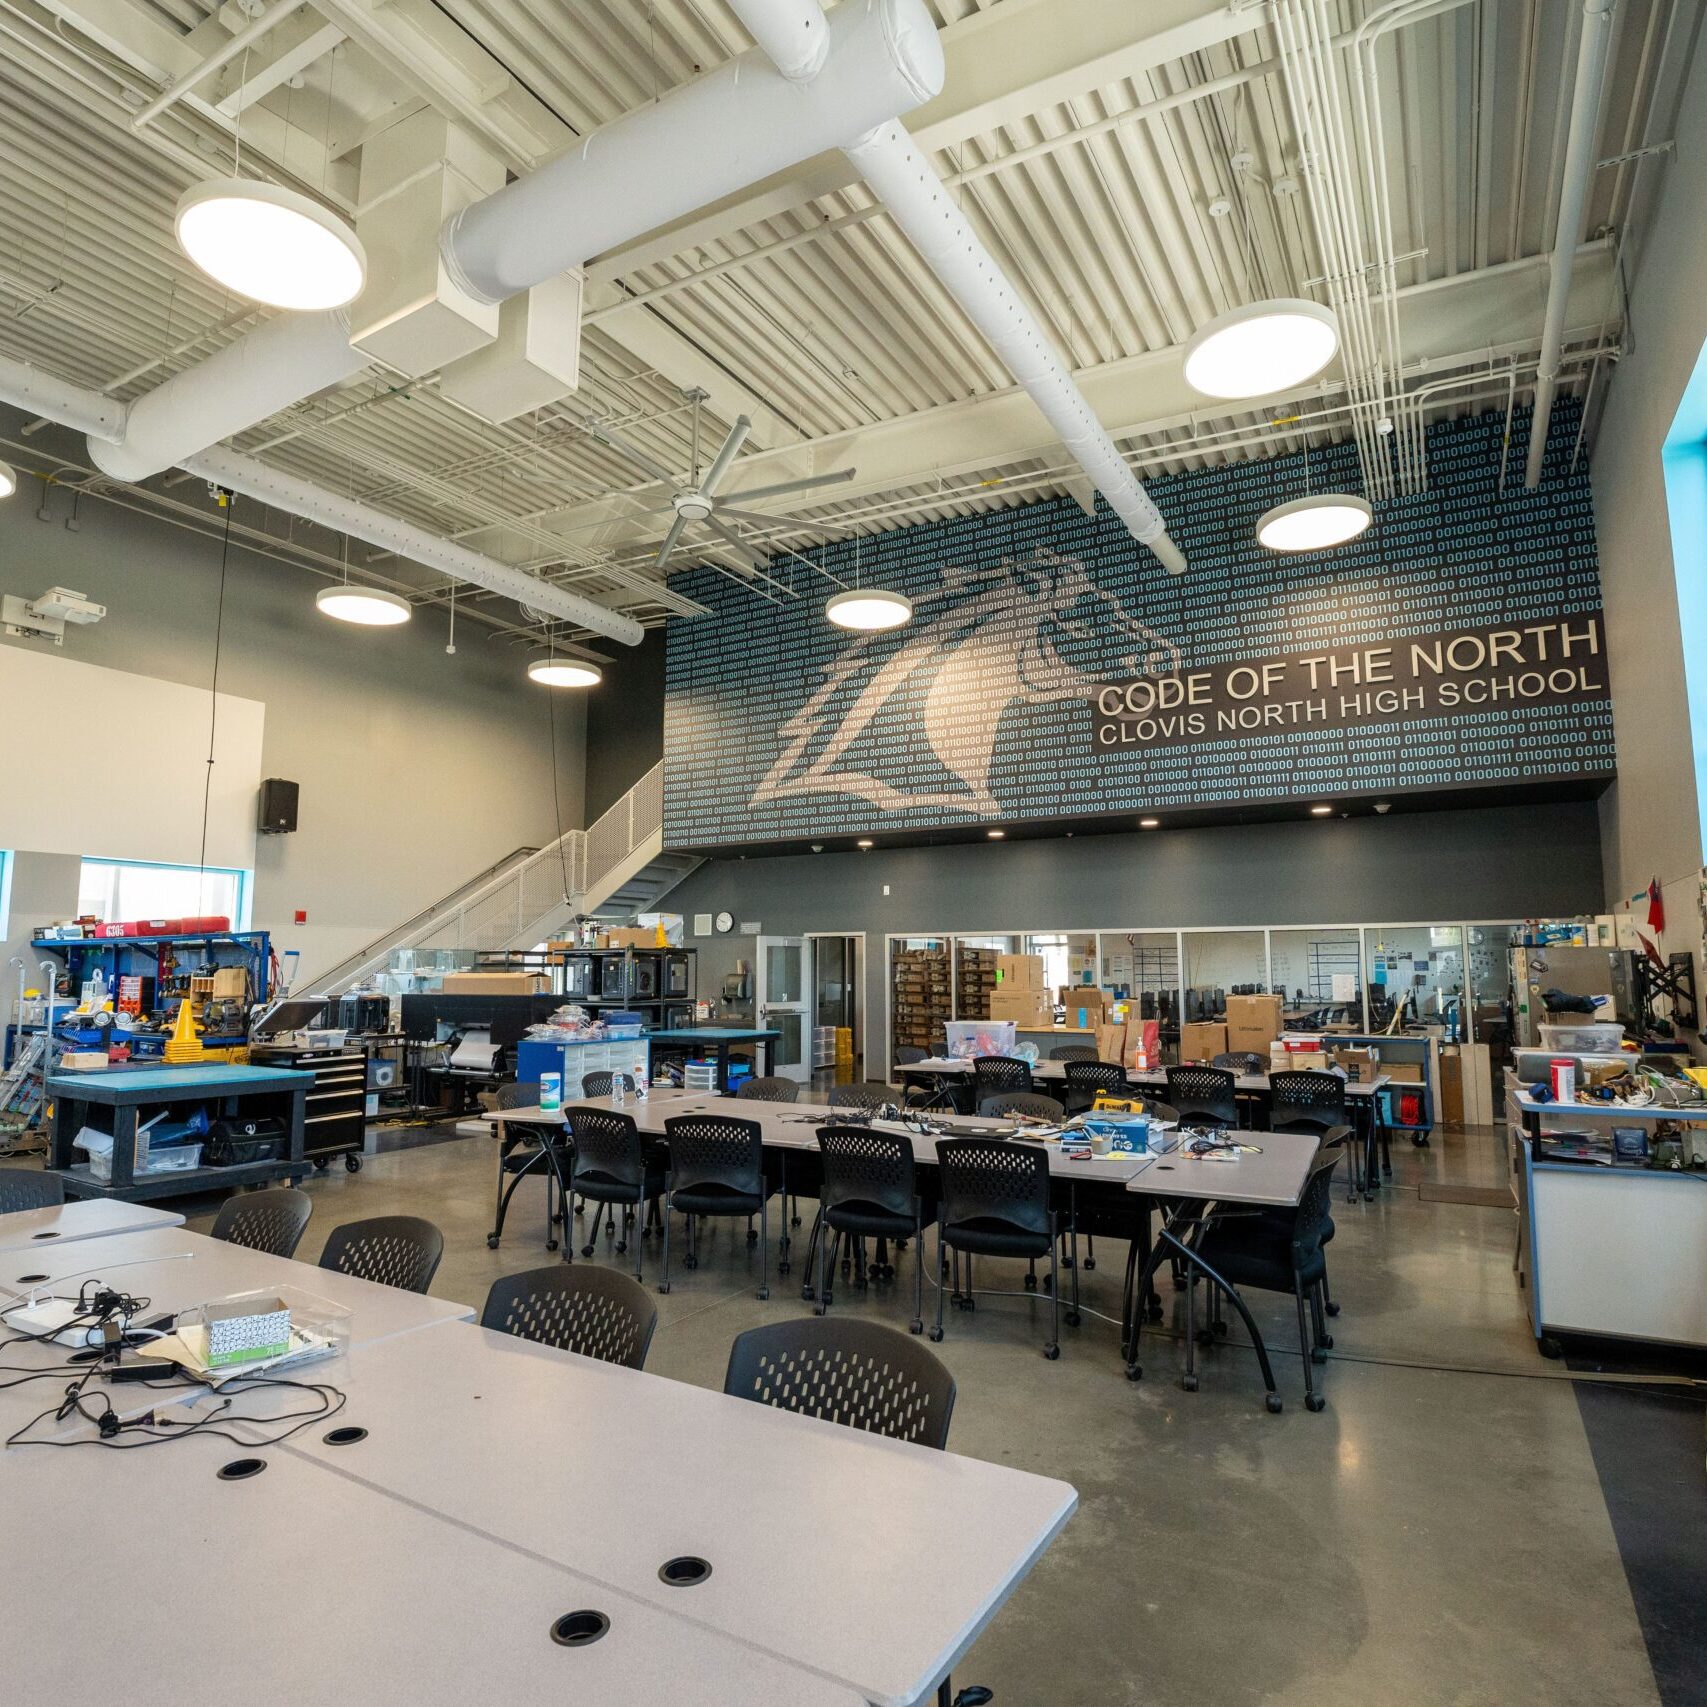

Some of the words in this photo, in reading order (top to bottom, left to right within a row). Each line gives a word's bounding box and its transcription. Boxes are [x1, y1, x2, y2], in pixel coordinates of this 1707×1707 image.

[1099, 575, 1136, 589] 01100101
[1382, 516, 1440, 534] 00100000
[1445, 506, 1489, 522] 01101111
[1494, 495, 1547, 513] 01100110
[1146, 578, 1180, 591] 01101111
[1232, 560, 1275, 575] 01100101
[1279, 549, 1333, 566] 00100000
[1337, 541, 1378, 555] 01101111
[1382, 531, 1431, 547] 01100110
[1436, 518, 1497, 537] 00100000
[1502, 507, 1555, 525] 01110100
[1231, 583, 1282, 599] 00100000
[1287, 575, 1332, 590] 01110100
[1337, 565, 1388, 581] 01101000
[1393, 555, 1441, 571] 01100101
[1447, 543, 1508, 562] 00100000
[1514, 533, 1568, 550] 01001110
[1234, 573, 1271, 587] 01101111
[1276, 564, 1320, 579] 01100110
[1324, 553, 1380, 570] 00100000
[1384, 543, 1433, 560] 01110100
[1438, 533, 1492, 550] 01101000
[1497, 522, 1549, 539] 01100101
[1089, 623, 1127, 636] 01100101
[1224, 599, 1267, 613] 01100110
[1272, 589, 1325, 605] 00100000
[1331, 580, 1377, 595] 01110100
[1383, 570, 1435, 586] 01101000
[1441, 560, 1492, 576] 01100101
[1498, 548, 1562, 567] 00100000
[1101, 643, 1147, 657] 00100000
[1244, 620, 1287, 634] 01100101
[1292, 611, 1346, 627] 00100000
[1351, 602, 1398, 617] 01001110
[1403, 595, 1446, 609] 01101111
[1451, 585, 1503, 601] 01110010
[1508, 576, 1562, 592] 01110100
[1241, 608, 1284, 622] 01110100
[1289, 599, 1337, 614] 01101000
[1342, 591, 1389, 606] 01100101
[1395, 580, 1453, 597] 00100000
[1459, 570, 1511, 587] 01001110
[1516, 561, 1564, 577] 01101111
[1248, 632, 1291, 646] 01001110
[1296, 625, 1335, 639] 01101111
[1340, 617, 1387, 632] 01110010
[1392, 609, 1441, 624] 01110100
[1446, 600, 1501, 616] 01101000
[1506, 590, 1563, 607] 01010100
[1235, 647, 1278, 660] 01110010
[1283, 639, 1328, 653] 01110100
[1332, 631, 1383, 646] 01101000
[1387, 623, 1439, 638] 01010100
[1444, 614, 1499, 629] 01101000
[1504, 605, 1557, 621] 01100101
[1098, 673, 1211, 716] CODE
[1226, 663, 1286, 700] OF
[1299, 648, 1392, 690] THE
[1410, 618, 1598, 676] NORTH
[1100, 713, 1204, 745] CLOVIS
[1218, 698, 1325, 732] NORTH
[1341, 686, 1423, 718] HIGH
[1438, 664, 1601, 706] SCHOOL
[1144, 746, 1187, 757] 01010100
[1240, 735, 1283, 747] 01100101
[1288, 729, 1342, 742] 00100000
[1347, 722, 1398, 736] 01000011
[1403, 717, 1447, 730] 01101111
[1452, 711, 1507, 724] 01100100
[1512, 704, 1566, 718] 01100101
[1104, 762, 1146, 773] 01101000
[1250, 747, 1297, 759] 01000011
[1302, 742, 1342, 753] 01101111
[1348, 736, 1399, 749] 01100100
[1405, 730, 1455, 743] 01100101
[1461, 723, 1524, 737] 00100000
[1530, 717, 1577, 730] 01101111
[1105, 787, 1144, 797] 01100101
[1250, 773, 1288, 784] 01101111
[1293, 768, 1342, 780] 01100100
[1346, 764, 1394, 776] 01100101
[1399, 757, 1459, 771] 00100000
[1465, 753, 1510, 765] 01101111
[1516, 747, 1570, 760] 01100110
[1144, 770, 1187, 782] 01101000
[1239, 760, 1292, 772] 00100000
[1298, 755, 1347, 767] 01000011
[1353, 750, 1394, 762] 01101111
[1400, 744, 1454, 757] 01100100
[1460, 738, 1513, 751] 01100101
[1520, 731, 1586, 746] 00100000
[1243, 787, 1287, 798] 01100101
[1292, 781, 1347, 794] 00100000
[1352, 777, 1394, 789] 01101111
[1399, 772, 1450, 785] 01100110
[1455, 767, 1518, 780] 00100000
[1523, 761, 1578, 774] 01110100
[105, 925, 124, 937] 6305
